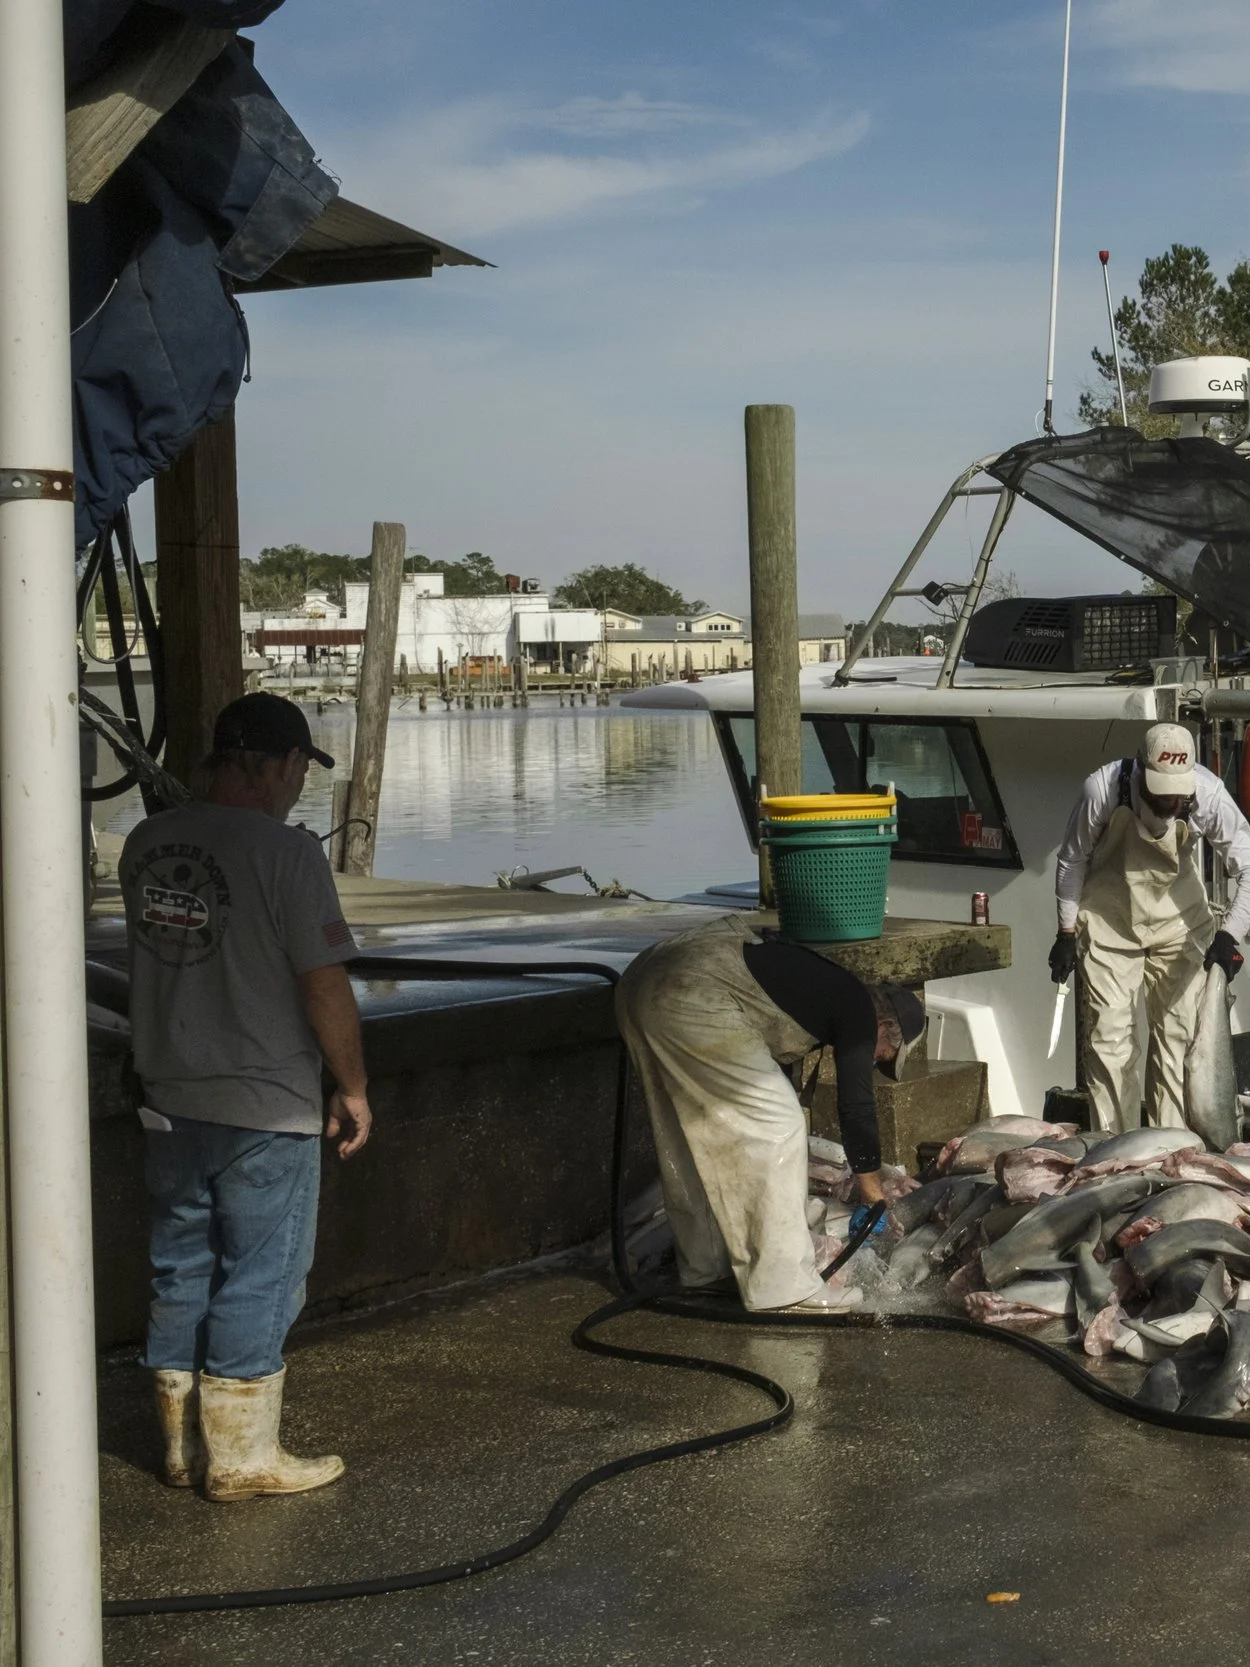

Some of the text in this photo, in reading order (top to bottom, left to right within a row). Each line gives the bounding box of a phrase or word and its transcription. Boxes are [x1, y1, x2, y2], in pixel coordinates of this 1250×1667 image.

[1025, 628, 1064, 638] FURRION
[1157, 751, 1188, 765] PTR
[202, 853, 232, 907] DOWN
